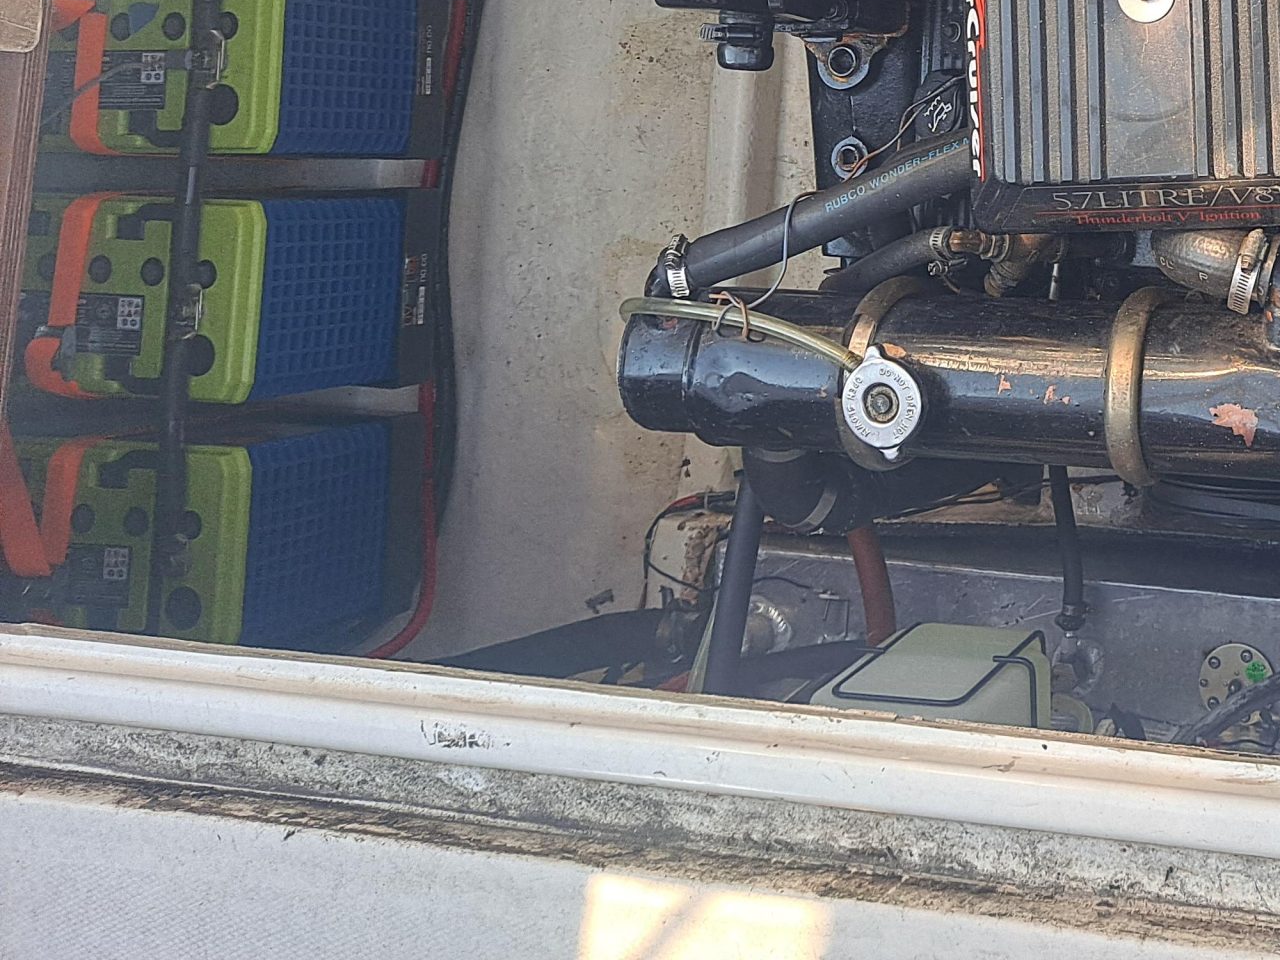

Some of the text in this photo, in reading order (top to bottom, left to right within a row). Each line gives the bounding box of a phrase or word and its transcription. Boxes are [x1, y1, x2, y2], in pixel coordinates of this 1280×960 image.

[825, 139, 961, 214] RUBCO WONDER-FLEX
[1076, 210, 1262, 225] Thunderbolt V Ignition
